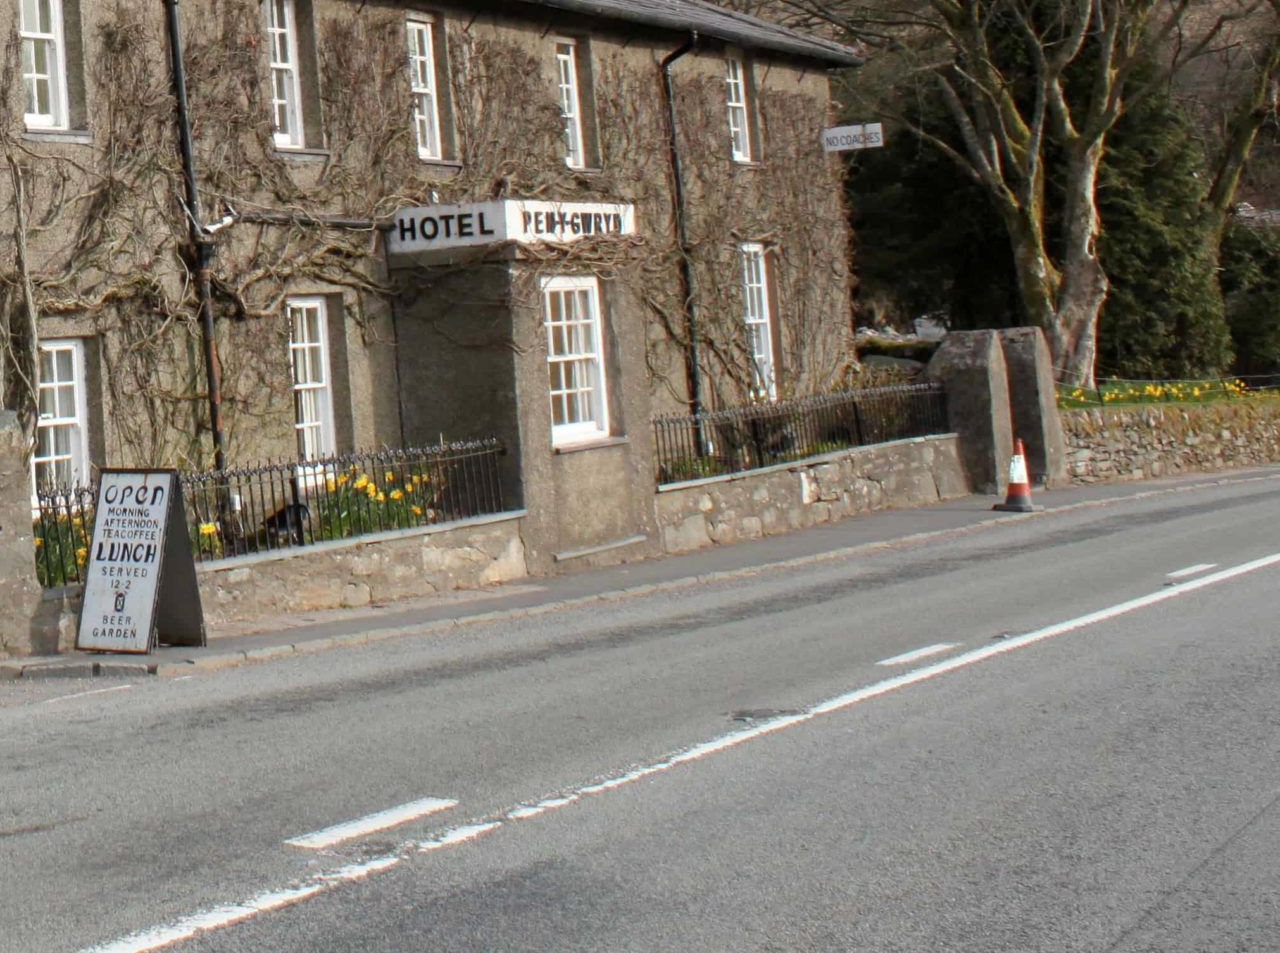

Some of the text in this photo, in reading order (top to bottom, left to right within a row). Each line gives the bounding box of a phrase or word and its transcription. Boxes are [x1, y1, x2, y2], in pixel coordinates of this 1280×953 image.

[825, 136, 839, 147] NO
[398, 212, 495, 241] HOTEL
[107, 507, 150, 517] MORNING
[103, 518, 159, 529] AFTERNOON
[96, 542, 157, 563] LUNCH
[101, 566, 148, 577] SERVED
[102, 615, 132, 625] BEER
[92, 627, 137, 639] GARDEN
